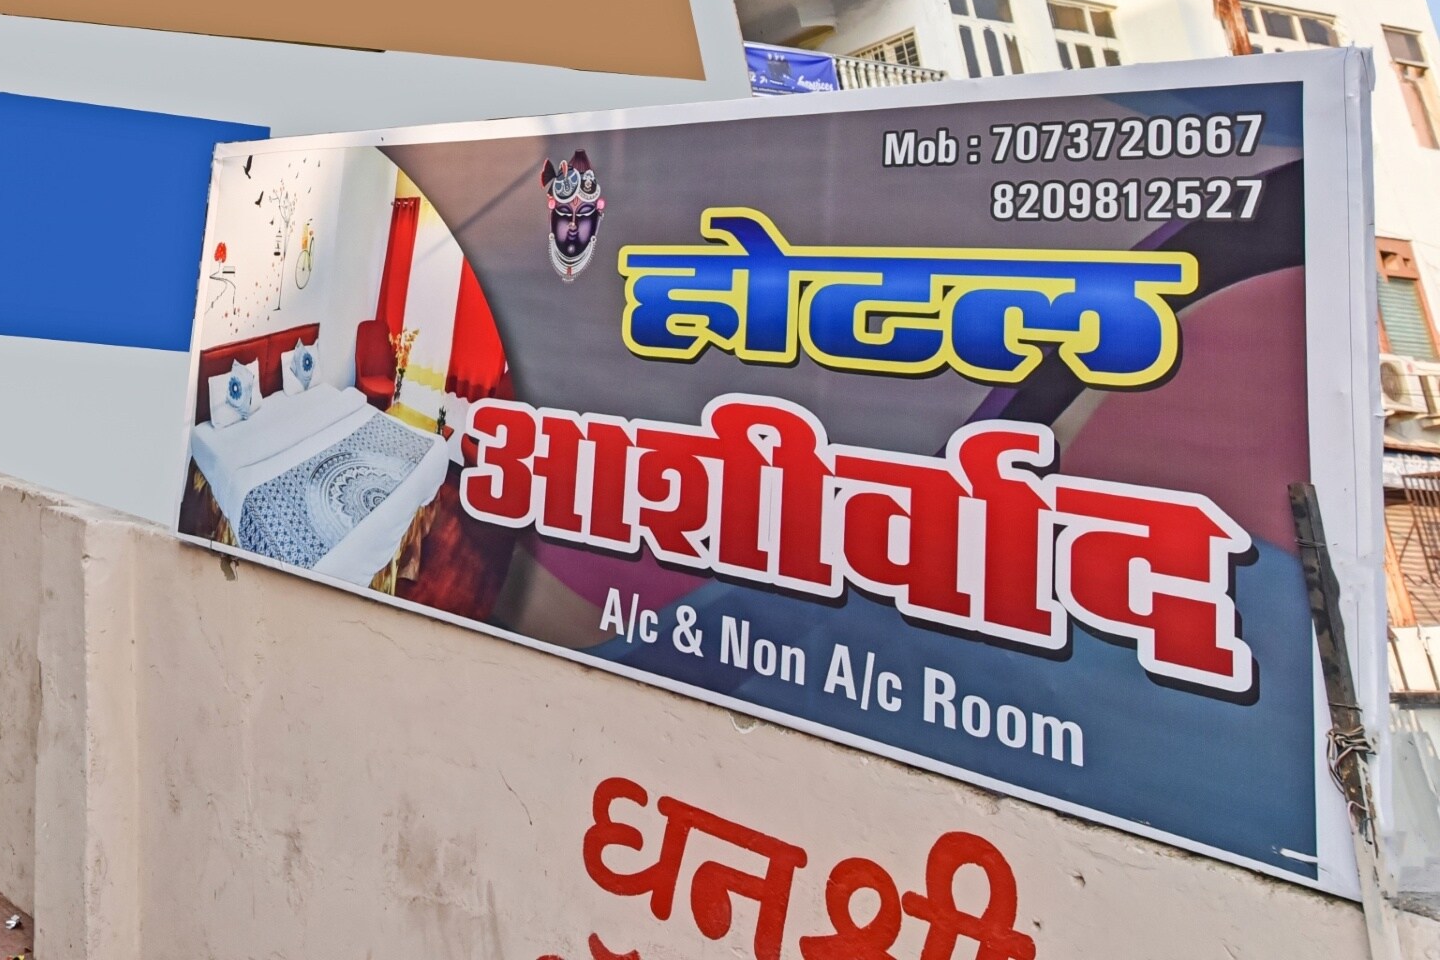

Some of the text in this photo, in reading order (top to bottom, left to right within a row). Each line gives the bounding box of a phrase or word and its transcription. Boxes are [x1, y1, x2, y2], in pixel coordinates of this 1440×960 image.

[992, 115, 1263, 163] 7073720667
[992, 180, 1263, 222] 8209812527
[618, 207, 1199, 388] होटल
[460, 393, 1253, 694] आशीर्वाद
[599, 587, 1085, 768] A/c & Non A/c Room
